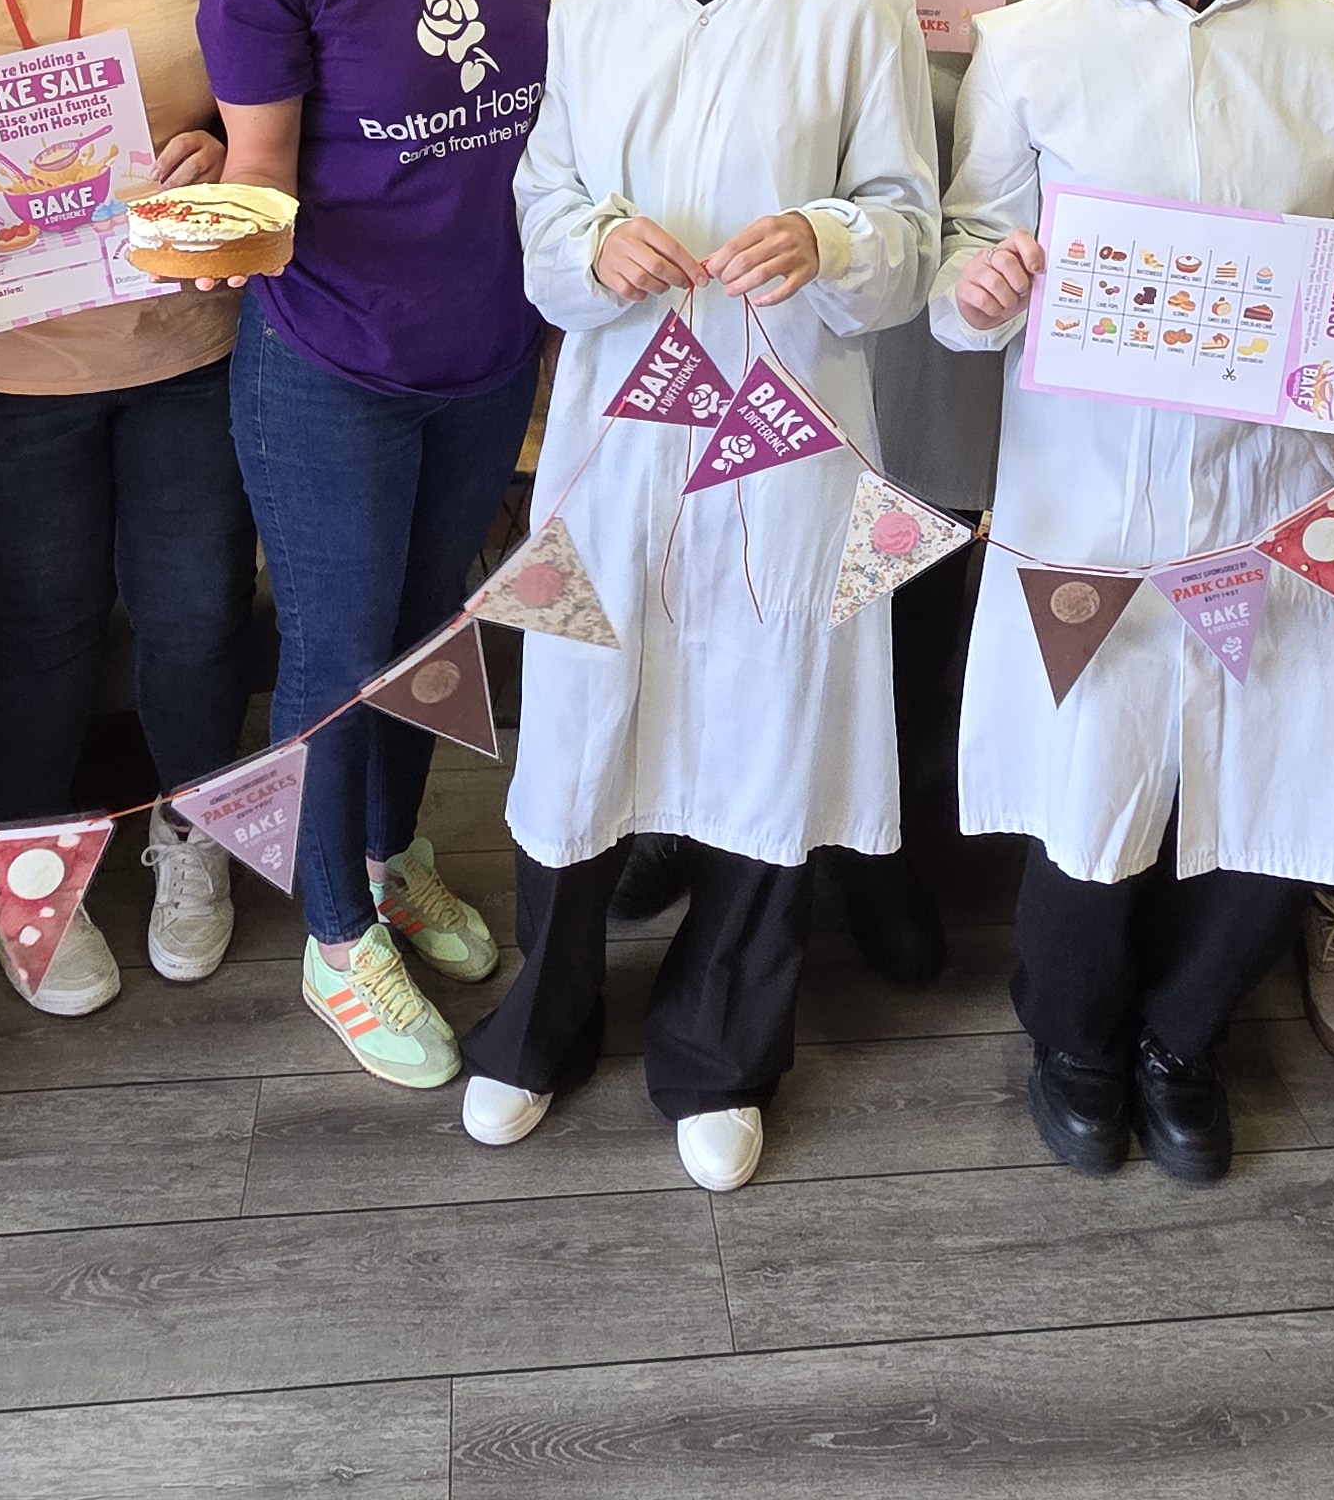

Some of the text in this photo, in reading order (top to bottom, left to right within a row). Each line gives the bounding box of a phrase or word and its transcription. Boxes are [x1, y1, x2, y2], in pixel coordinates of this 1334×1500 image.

[920, 19, 951, 33] AKES
[19, 52, 74, 75] holding
[76, 51, 86, 61] a
[43, 61, 109, 100] SALE
[29, 104, 63, 123] vital
[65, 92, 108, 113] funds
[475, 80, 545, 122] Hospi
[0, 122, 49, 144] Bolton
[51, 105, 113, 131] Hospice!
[359, 106, 466, 140] Bolton
[448, 133, 487, 152] from
[489, 125, 512, 144] the
[28, 186, 96, 220] BAKE
[627, 335, 690, 412] BAKE
[656, 353, 702, 416] A DIFFERENCE
[1296, 366, 1319, 408] BAKE
[737, 405, 790, 457] A DIFFERENCE
[746, 382, 817, 451] BAKE
[1172, 581, 1213, 603] PARK
[1215, 568, 1264, 589] CAKES
[1199, 602, 1251, 627] BAKE
[200, 798, 246, 826] PARK
[247, 773, 298, 804] CAKES
[233, 808, 288, 844] BAKE
